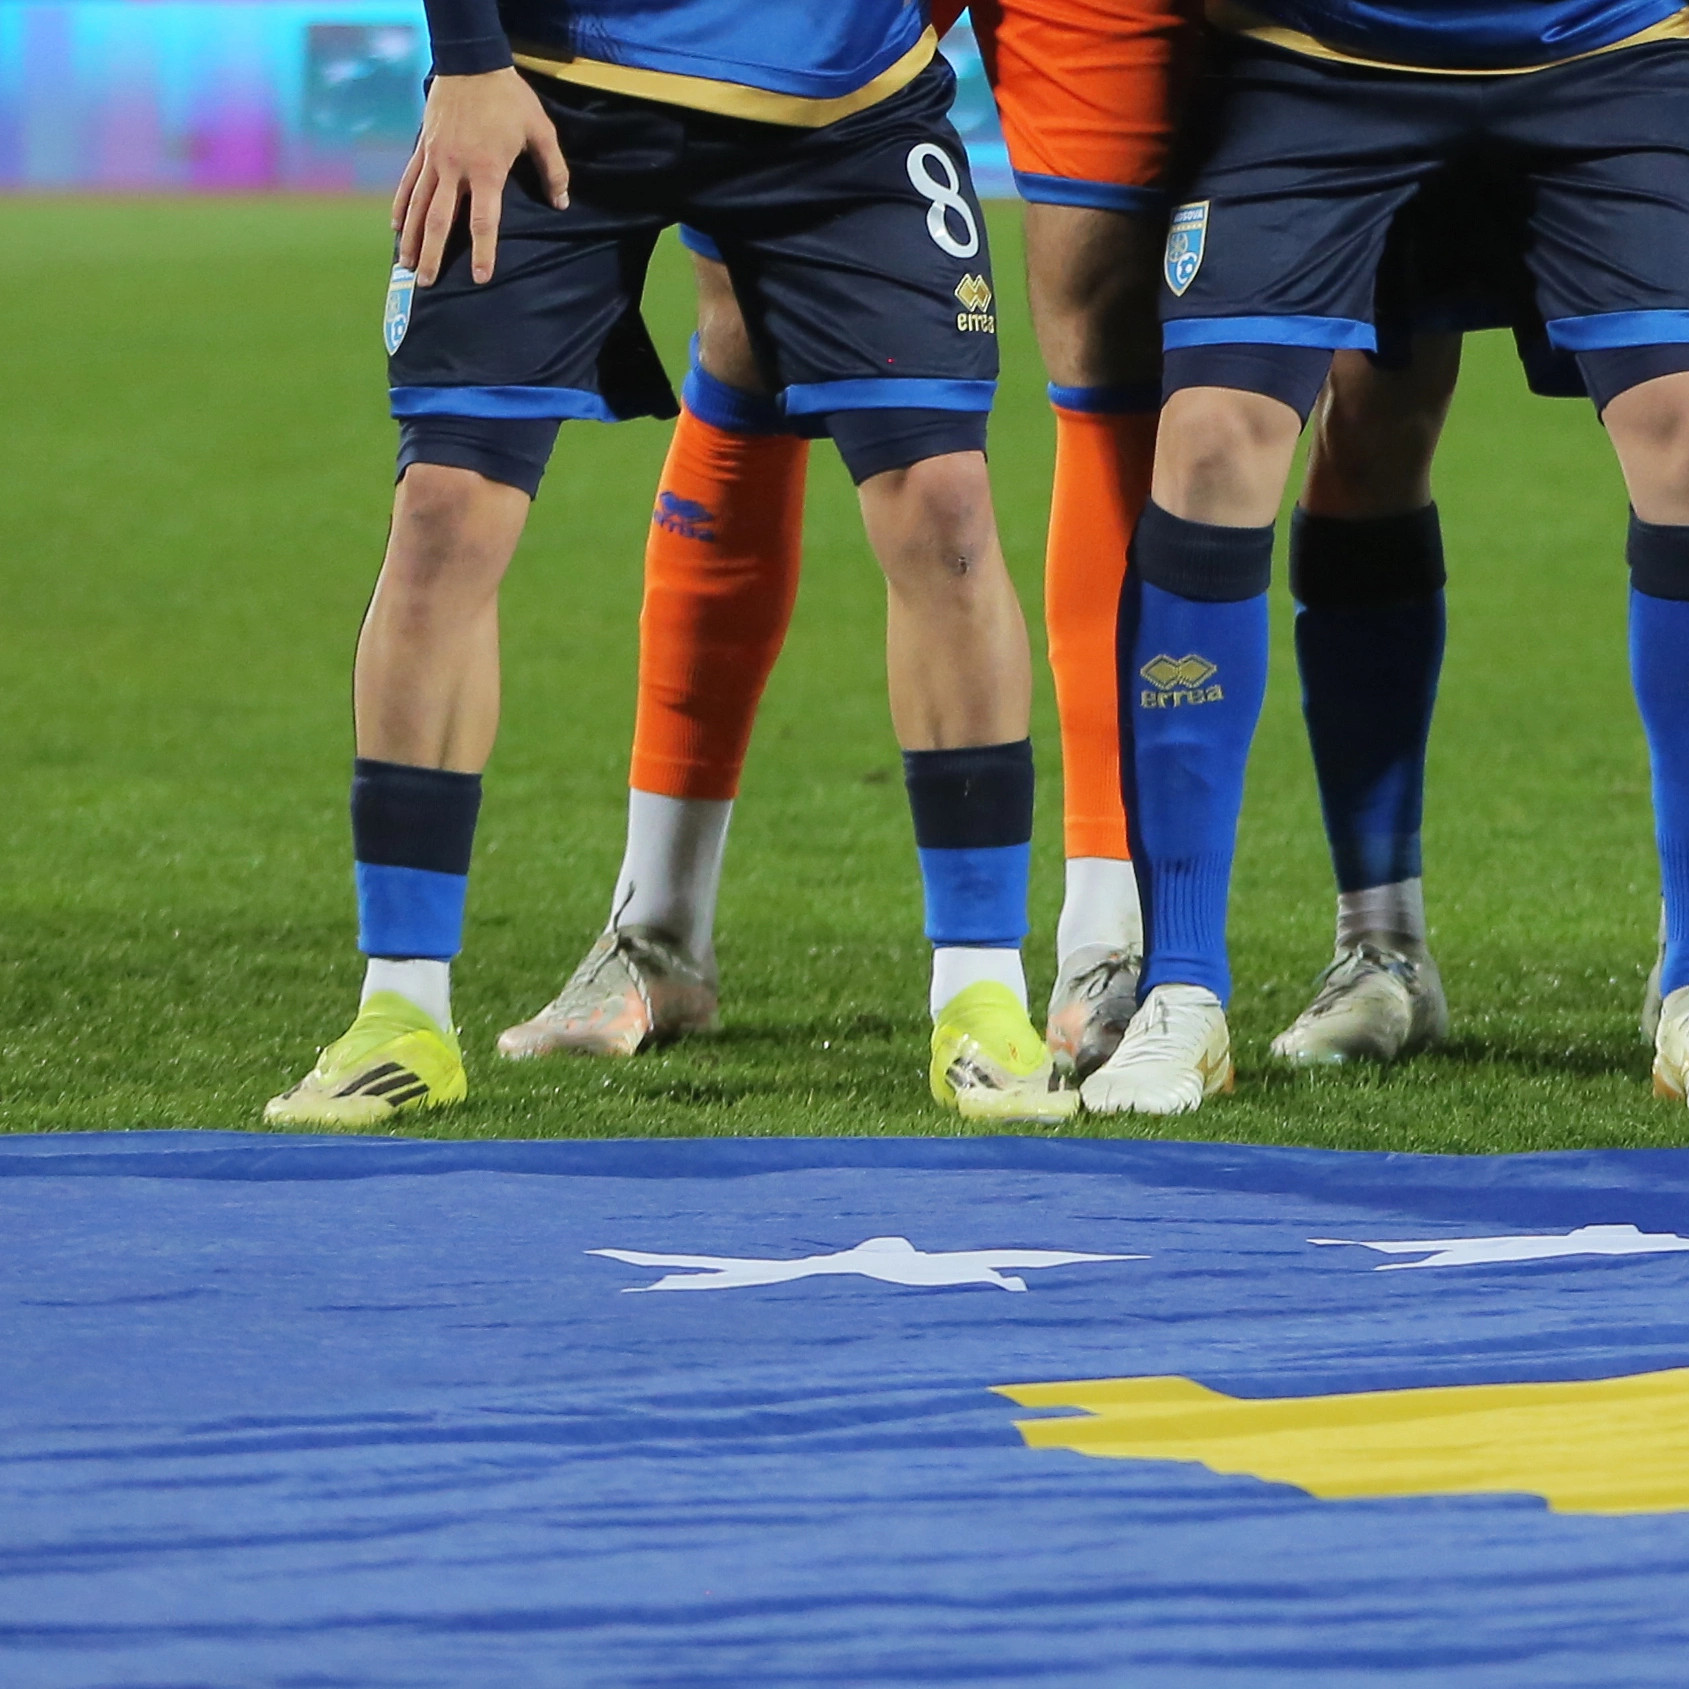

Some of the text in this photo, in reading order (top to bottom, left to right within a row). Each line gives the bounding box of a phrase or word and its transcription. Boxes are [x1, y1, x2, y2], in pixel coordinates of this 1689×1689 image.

[906, 142, 979, 258] 8
[956, 312, 996, 335] errea
[1140, 684, 1224, 709] errea
